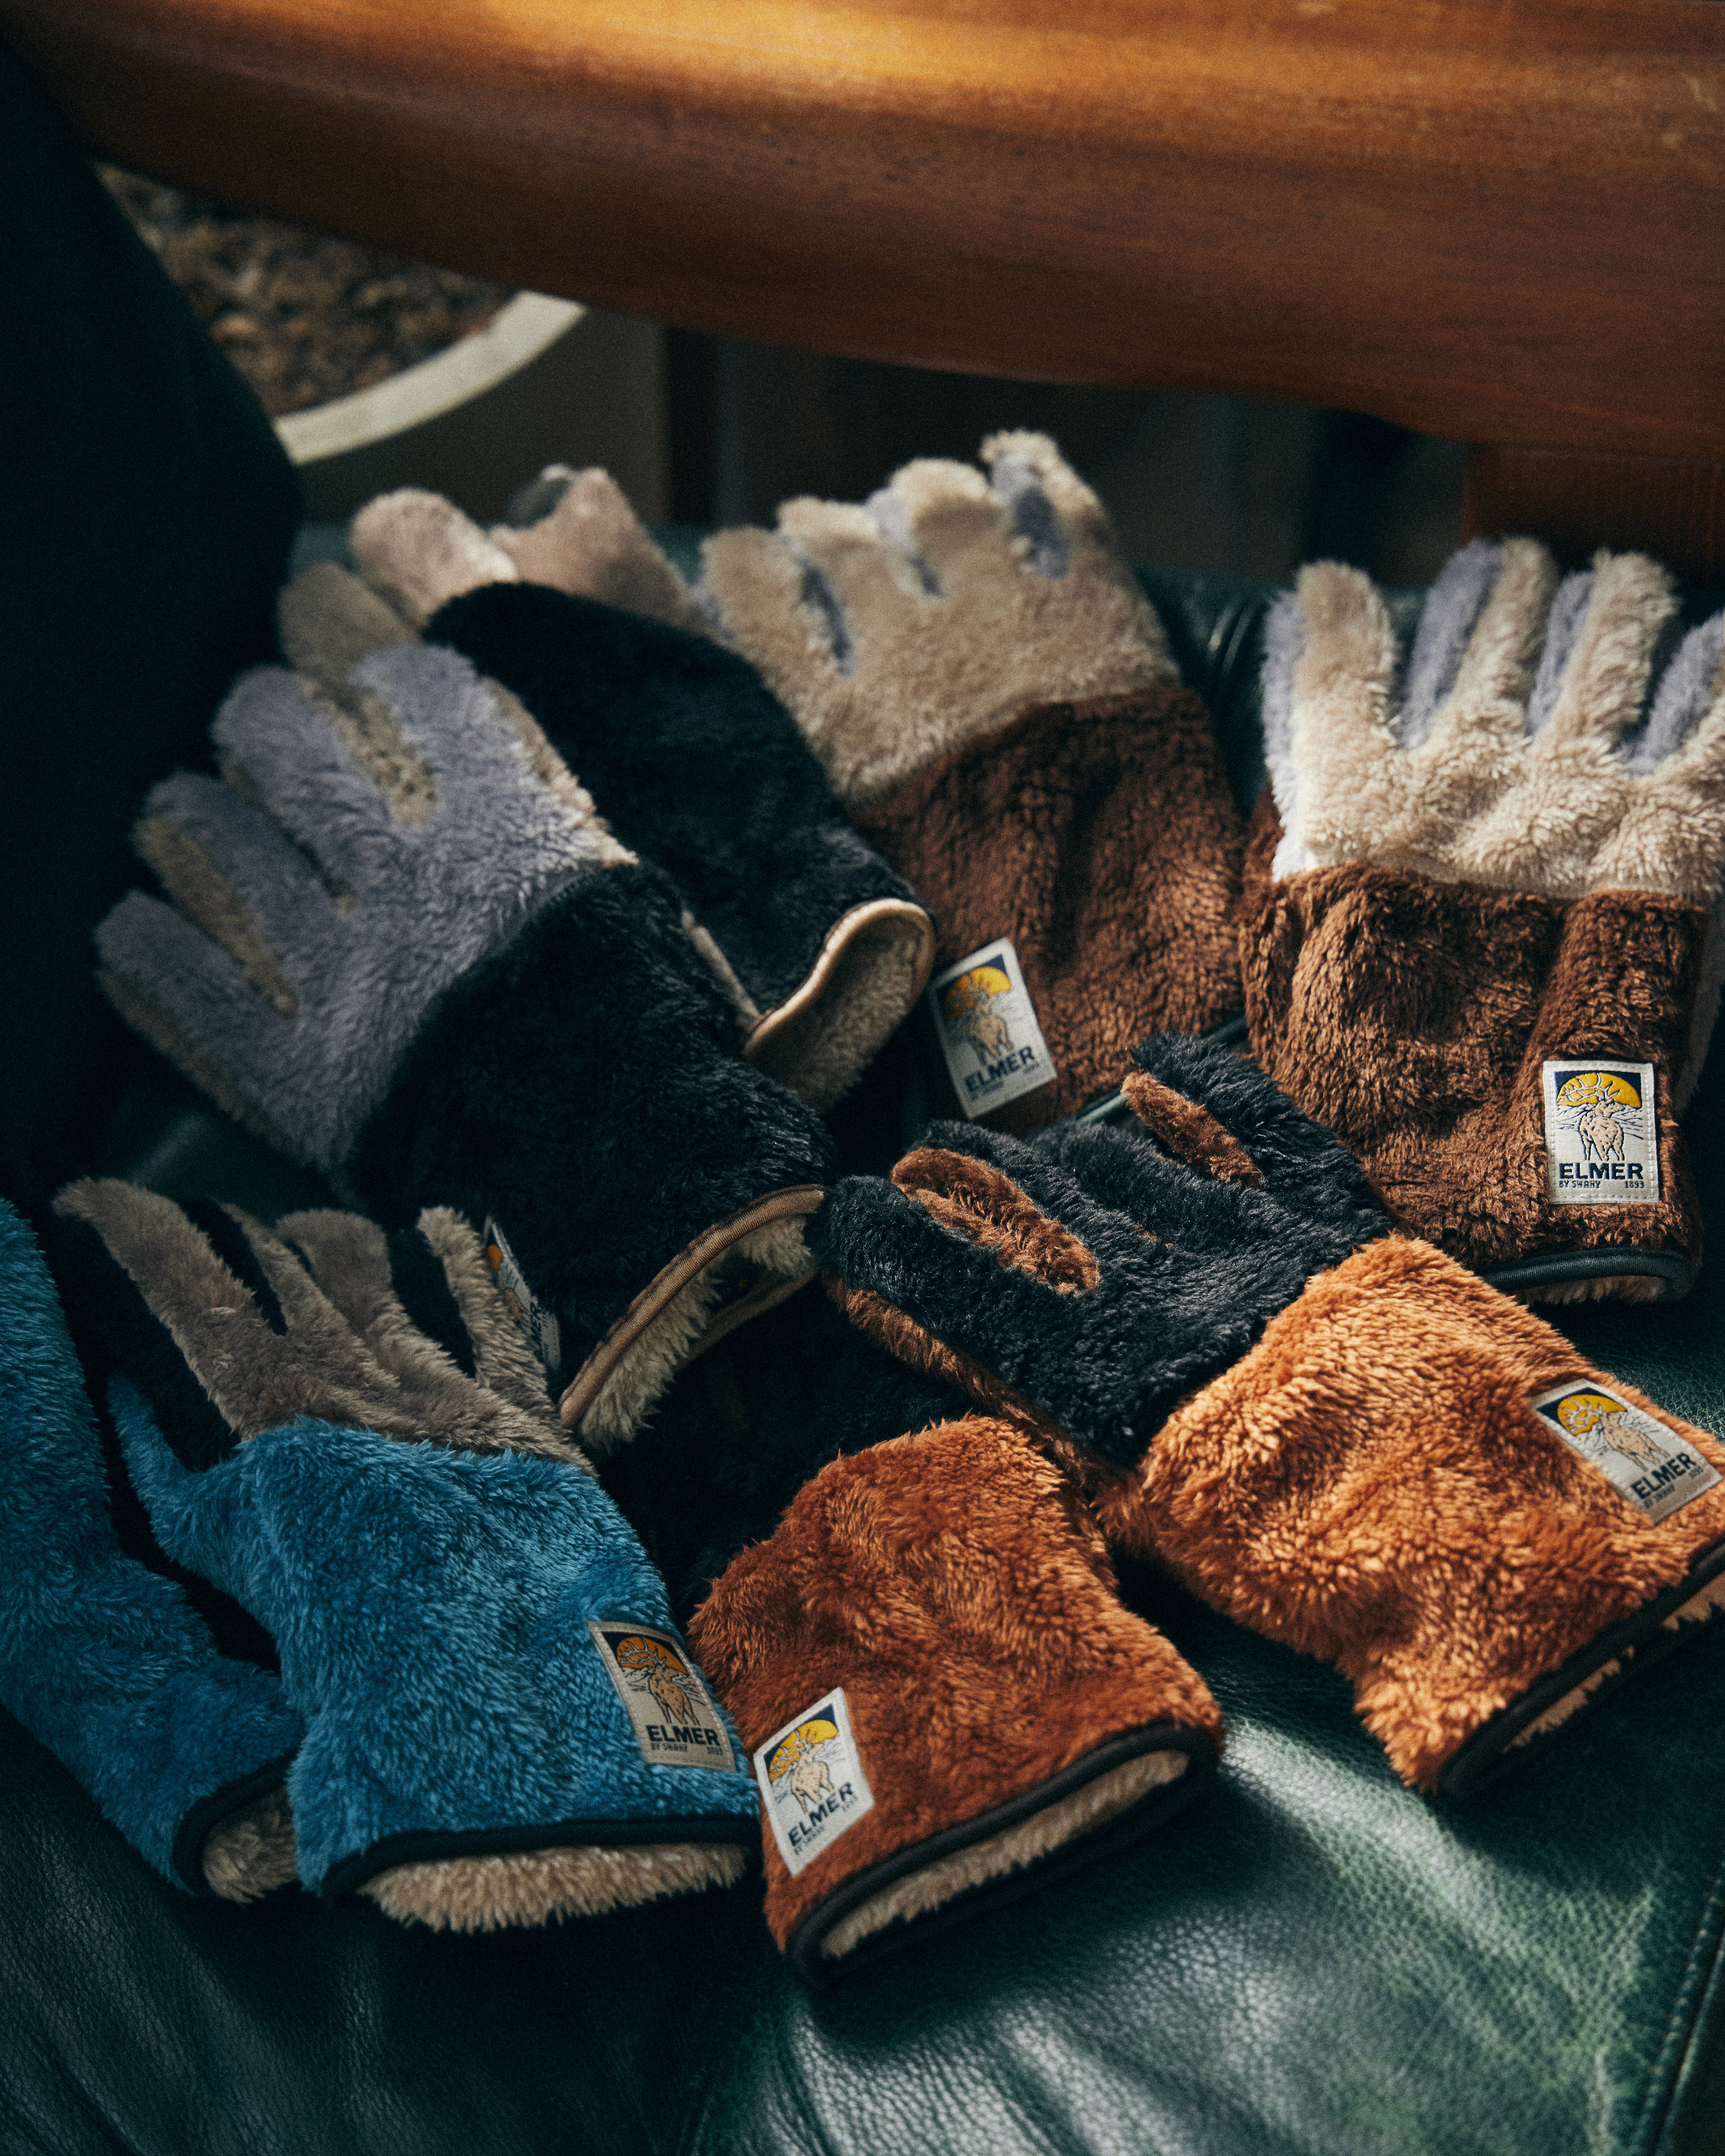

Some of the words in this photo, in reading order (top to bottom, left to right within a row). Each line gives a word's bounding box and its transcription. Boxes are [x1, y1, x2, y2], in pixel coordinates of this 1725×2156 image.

[965, 1046, 1035, 1092] ELMER
[1559, 1163, 1643, 1179] ELMER
[1630, 1452, 1696, 1499] ELMER
[646, 1724, 720, 1746] ELMER
[788, 1782, 853, 1846] ELMER
